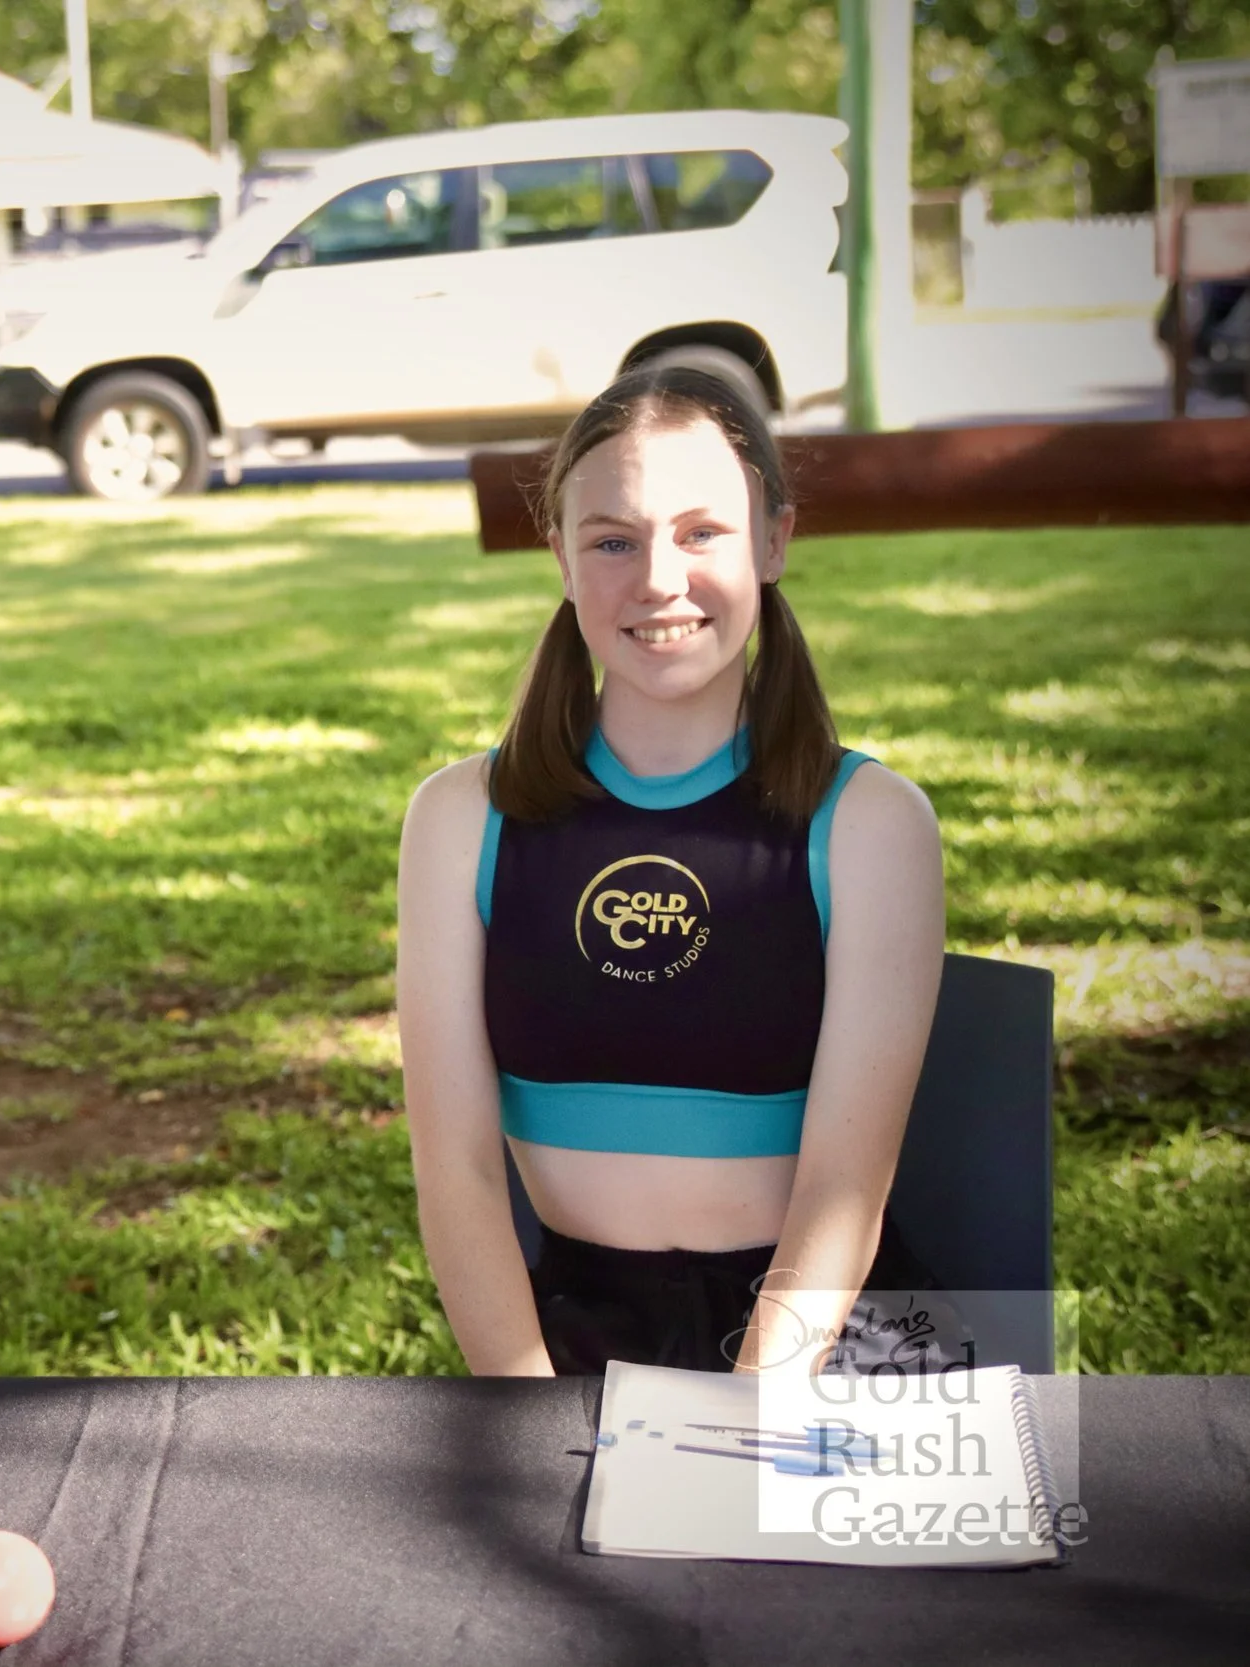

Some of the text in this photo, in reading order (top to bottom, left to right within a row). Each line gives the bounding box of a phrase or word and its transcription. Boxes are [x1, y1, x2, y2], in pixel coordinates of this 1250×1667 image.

[593, 889, 687, 925] GOLD
[610, 912, 697, 949] CITY
[601, 927, 710, 982] DANCE STUDIOS
